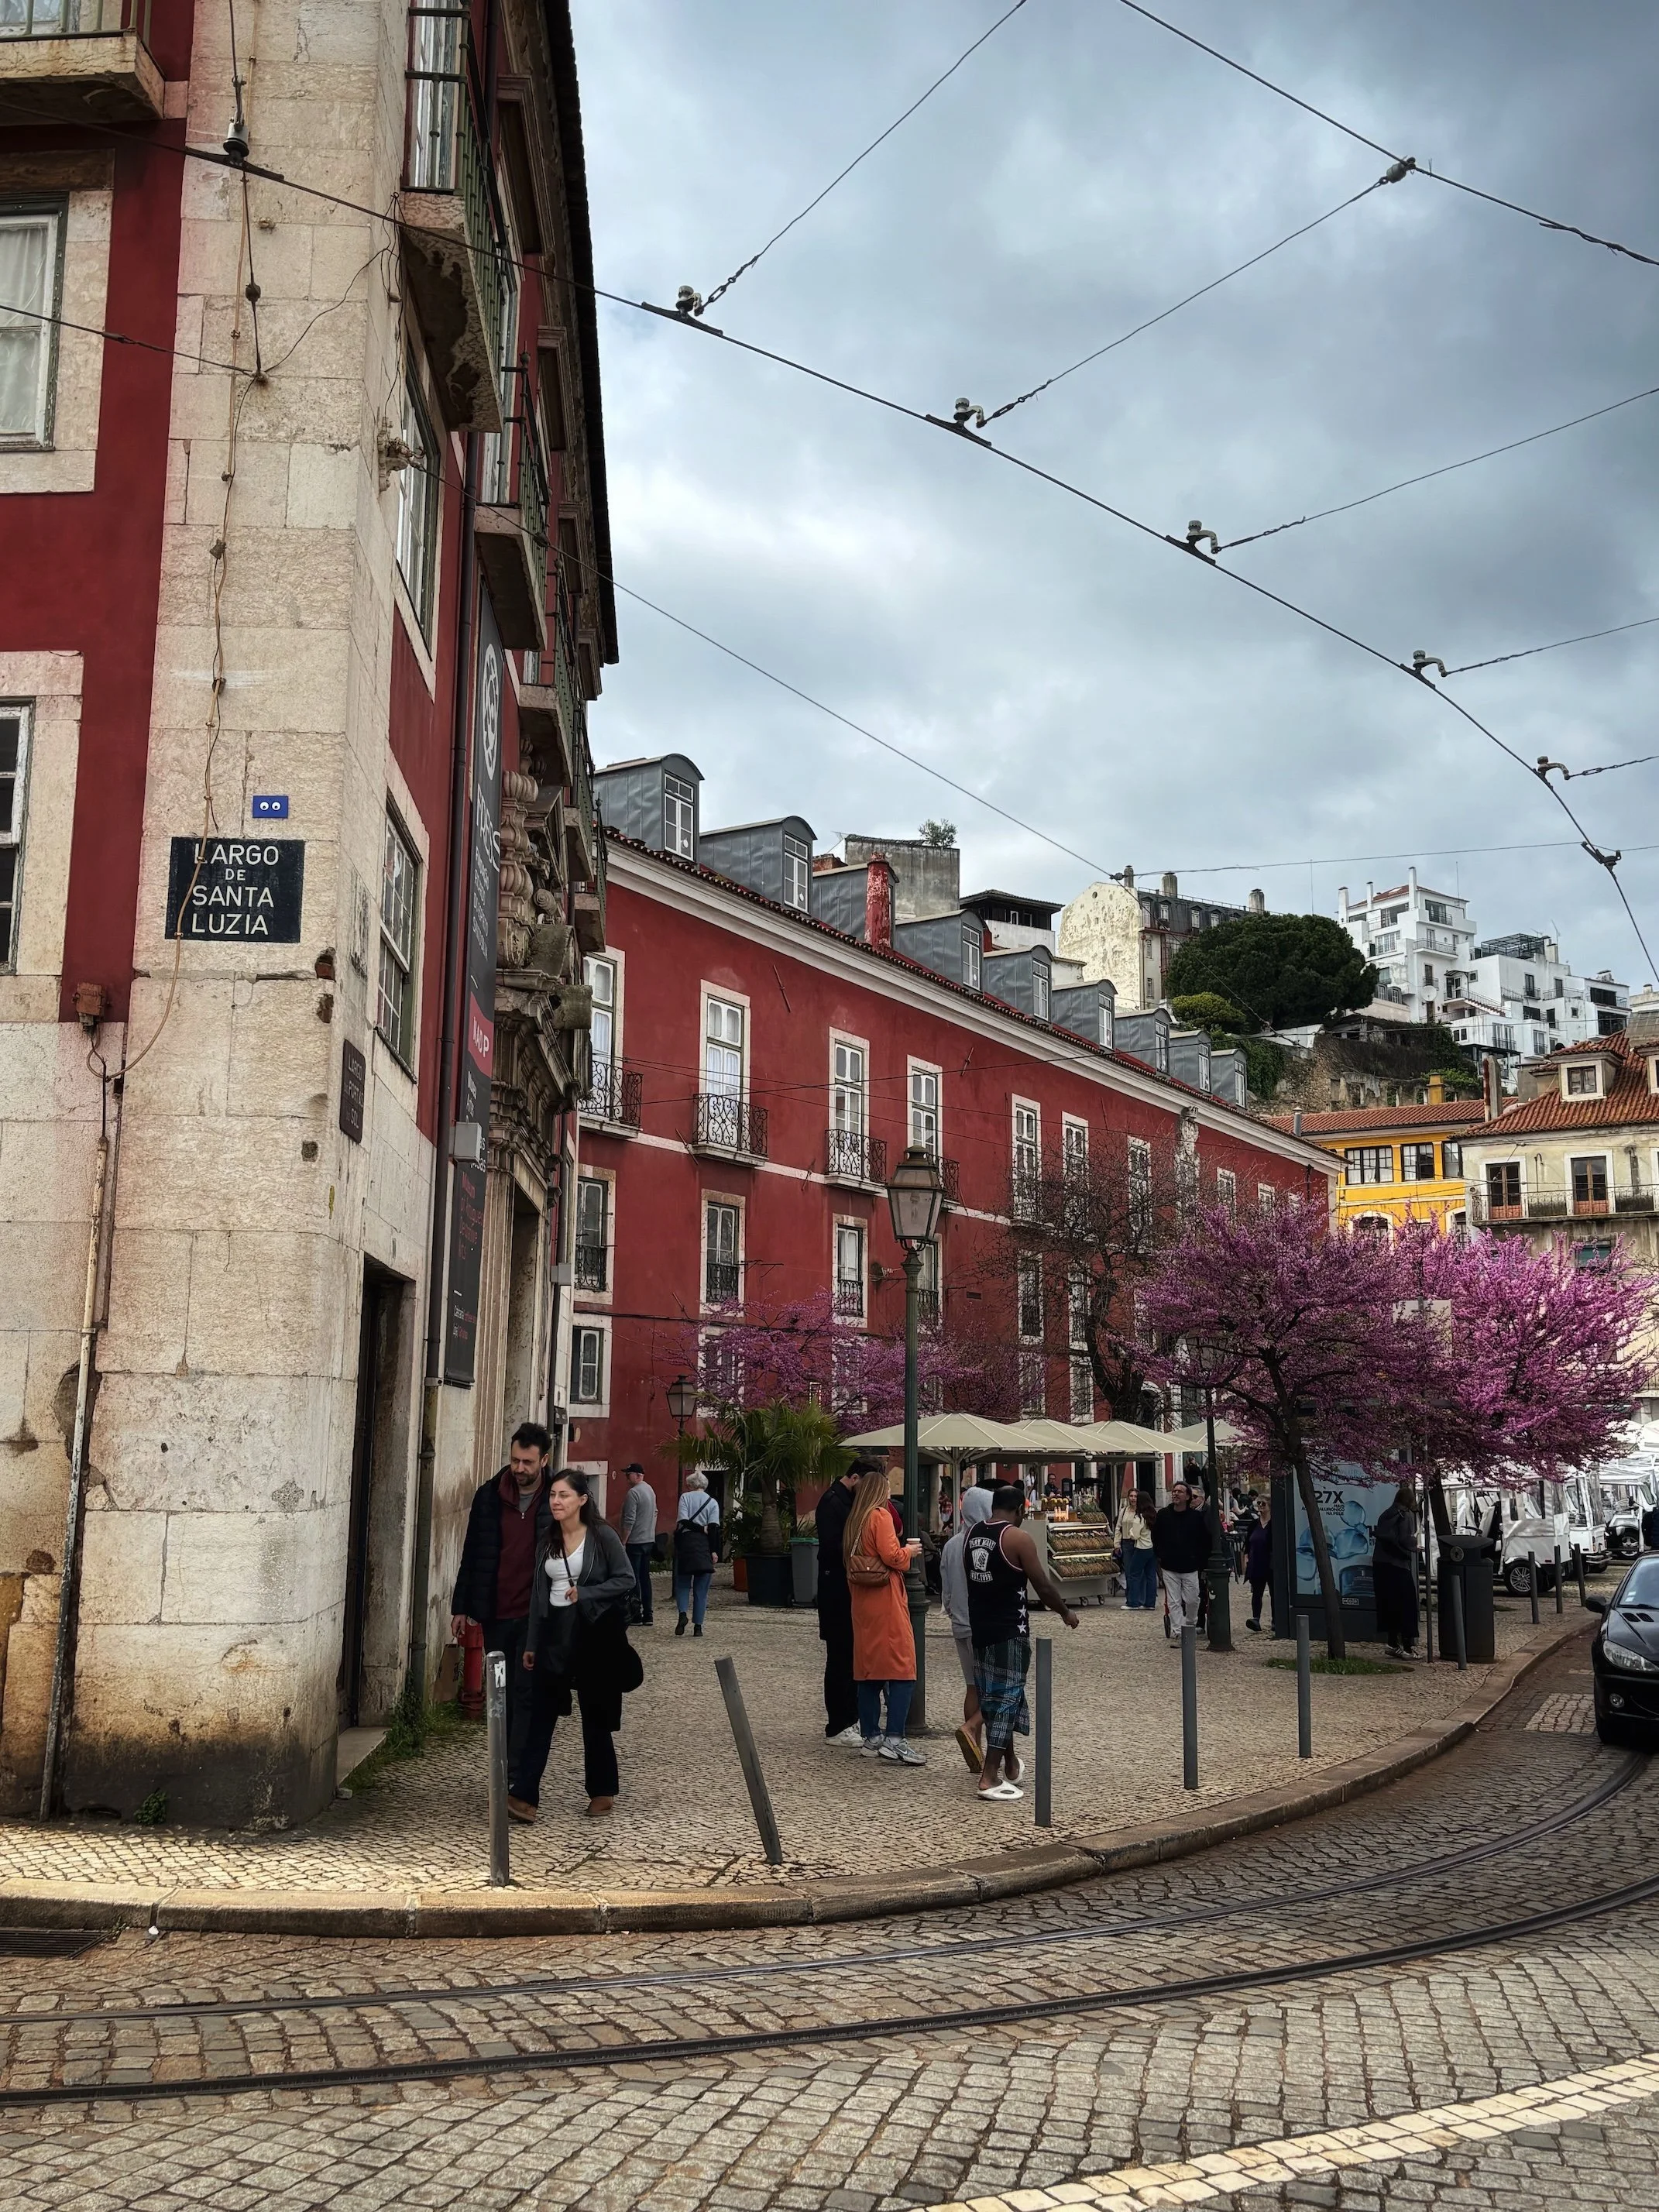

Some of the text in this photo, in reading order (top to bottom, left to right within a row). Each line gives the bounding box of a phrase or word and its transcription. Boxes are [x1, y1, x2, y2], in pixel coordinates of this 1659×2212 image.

[194, 843, 280, 866] LARGO
[225, 868, 246, 881] DE
[192, 885, 274, 908] SANTA
[191, 913, 269, 936] LUZIA
[348, 1055, 362, 1081] LARGO
[349, 1080, 364, 1108] PORTAS
[351, 1108, 359, 1128] SOL
